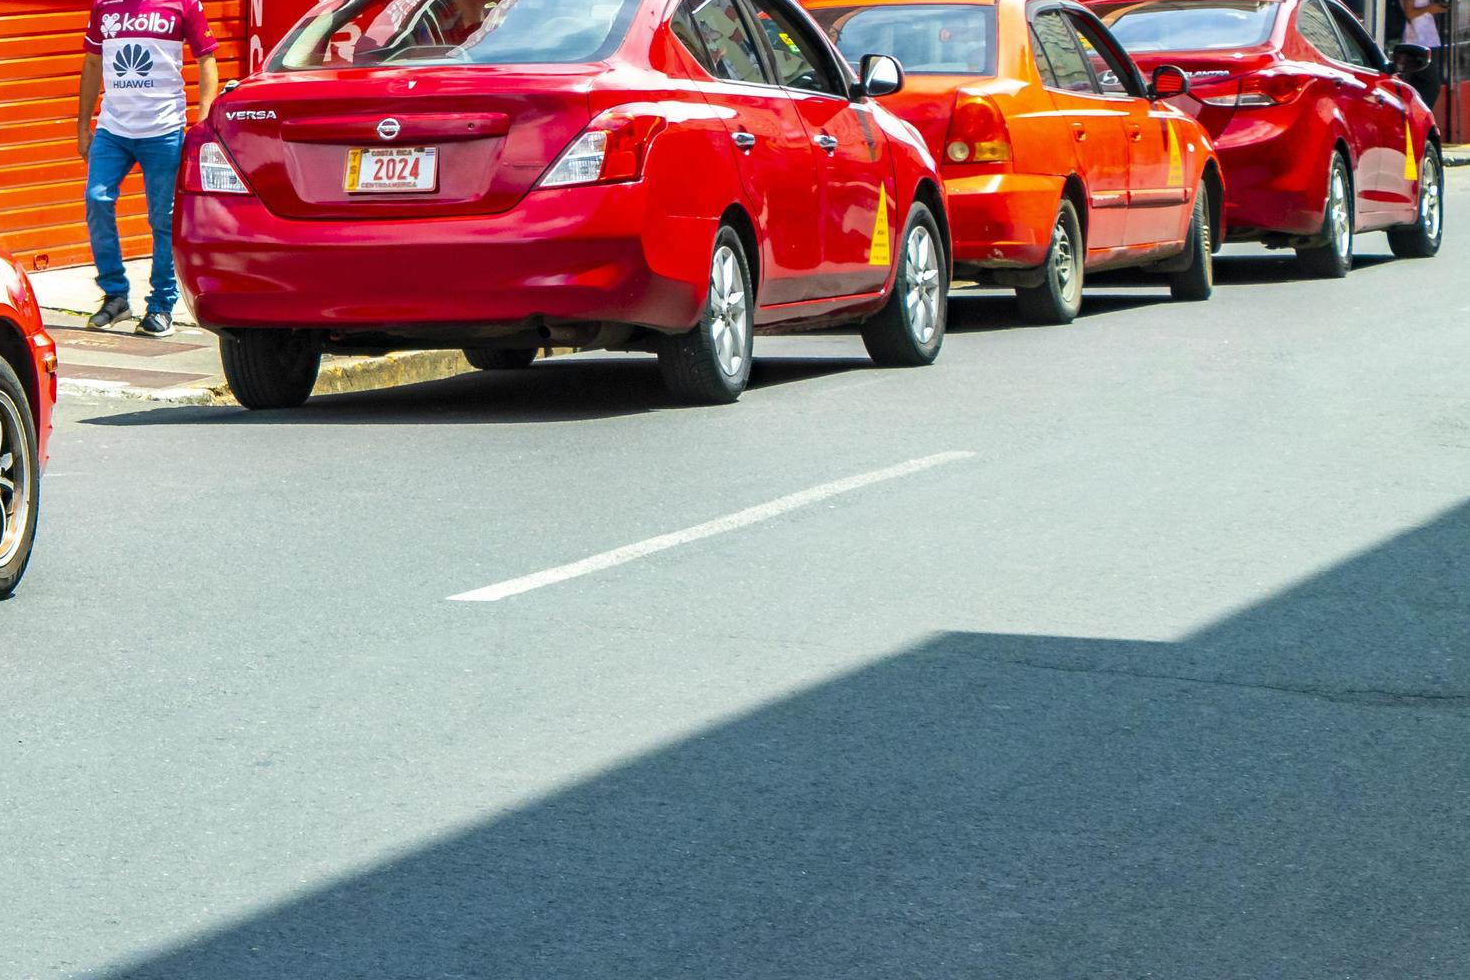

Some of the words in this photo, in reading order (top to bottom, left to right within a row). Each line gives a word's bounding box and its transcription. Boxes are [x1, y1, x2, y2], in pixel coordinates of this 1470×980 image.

[122, 13, 176, 34] kölbi
[113, 80, 154, 89] HUAWEI
[226, 110, 277, 121] VERSA
[374, 157, 420, 181] 2024
